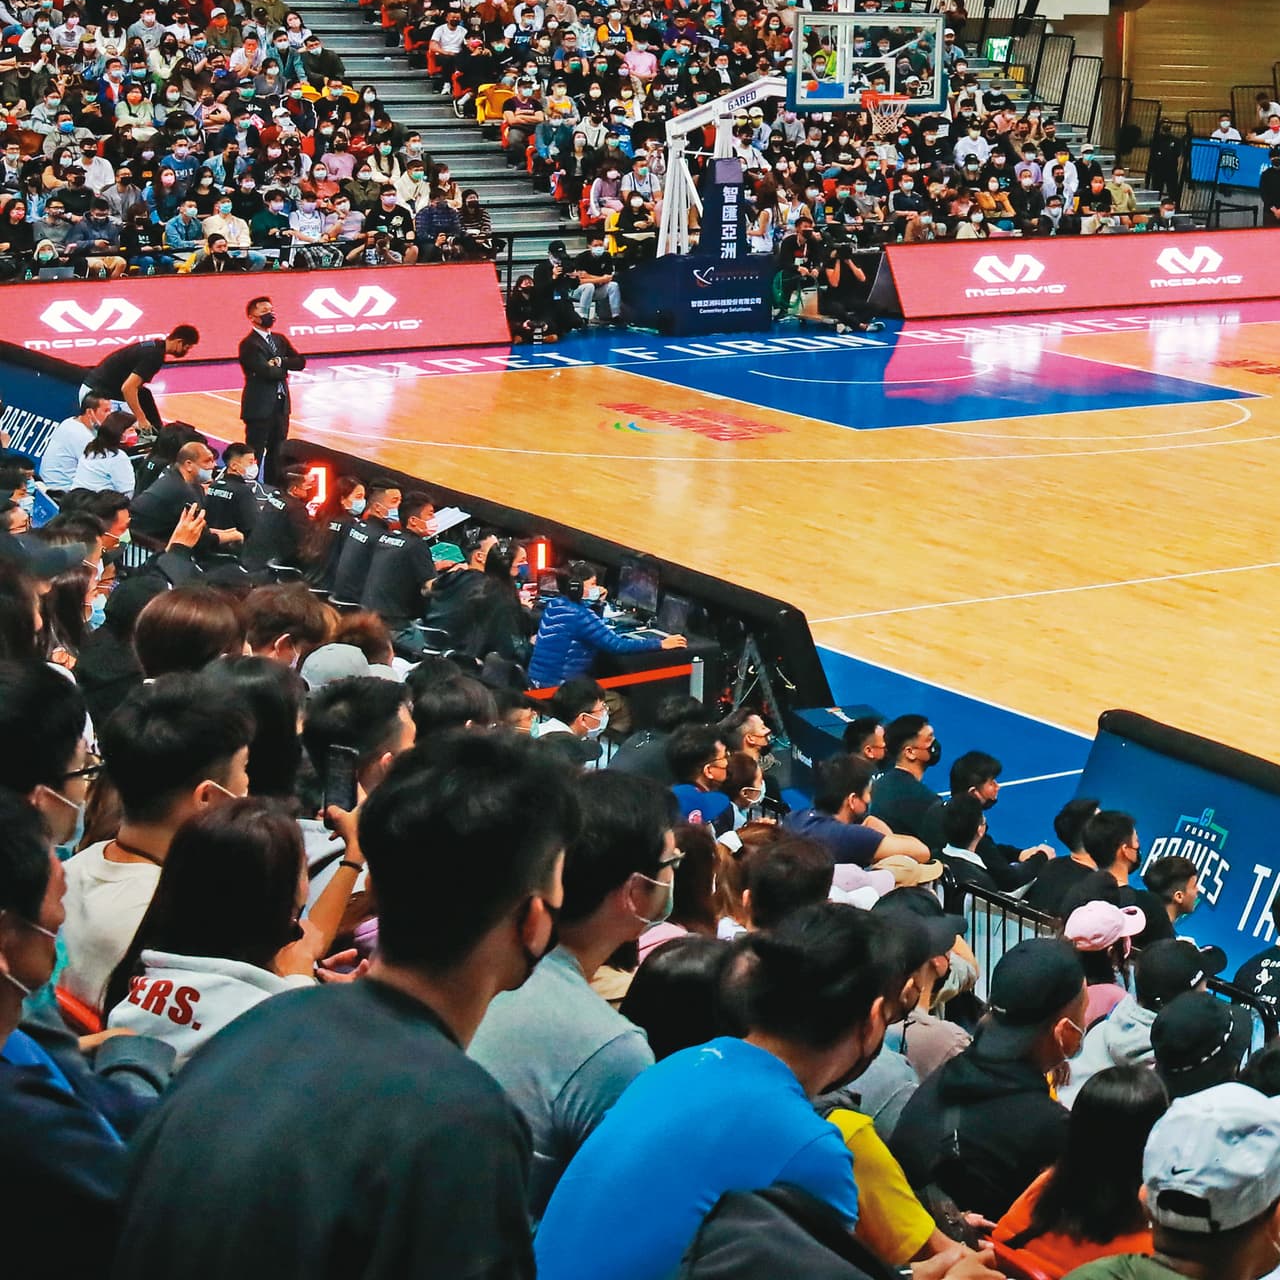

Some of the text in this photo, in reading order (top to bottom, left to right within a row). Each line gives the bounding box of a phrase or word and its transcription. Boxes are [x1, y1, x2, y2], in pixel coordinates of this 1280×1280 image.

[727, 89, 758, 112] GARED
[720, 185, 739, 260] 智匯亞洲
[965, 284, 1066, 299] MCDAVID
[1150, 275, 1243, 289] MCDAVID
[289, 318, 420, 337] MCDAVID
[611, 331, 888, 363] FUBON
[1184, 824, 1218, 843] FUBON
